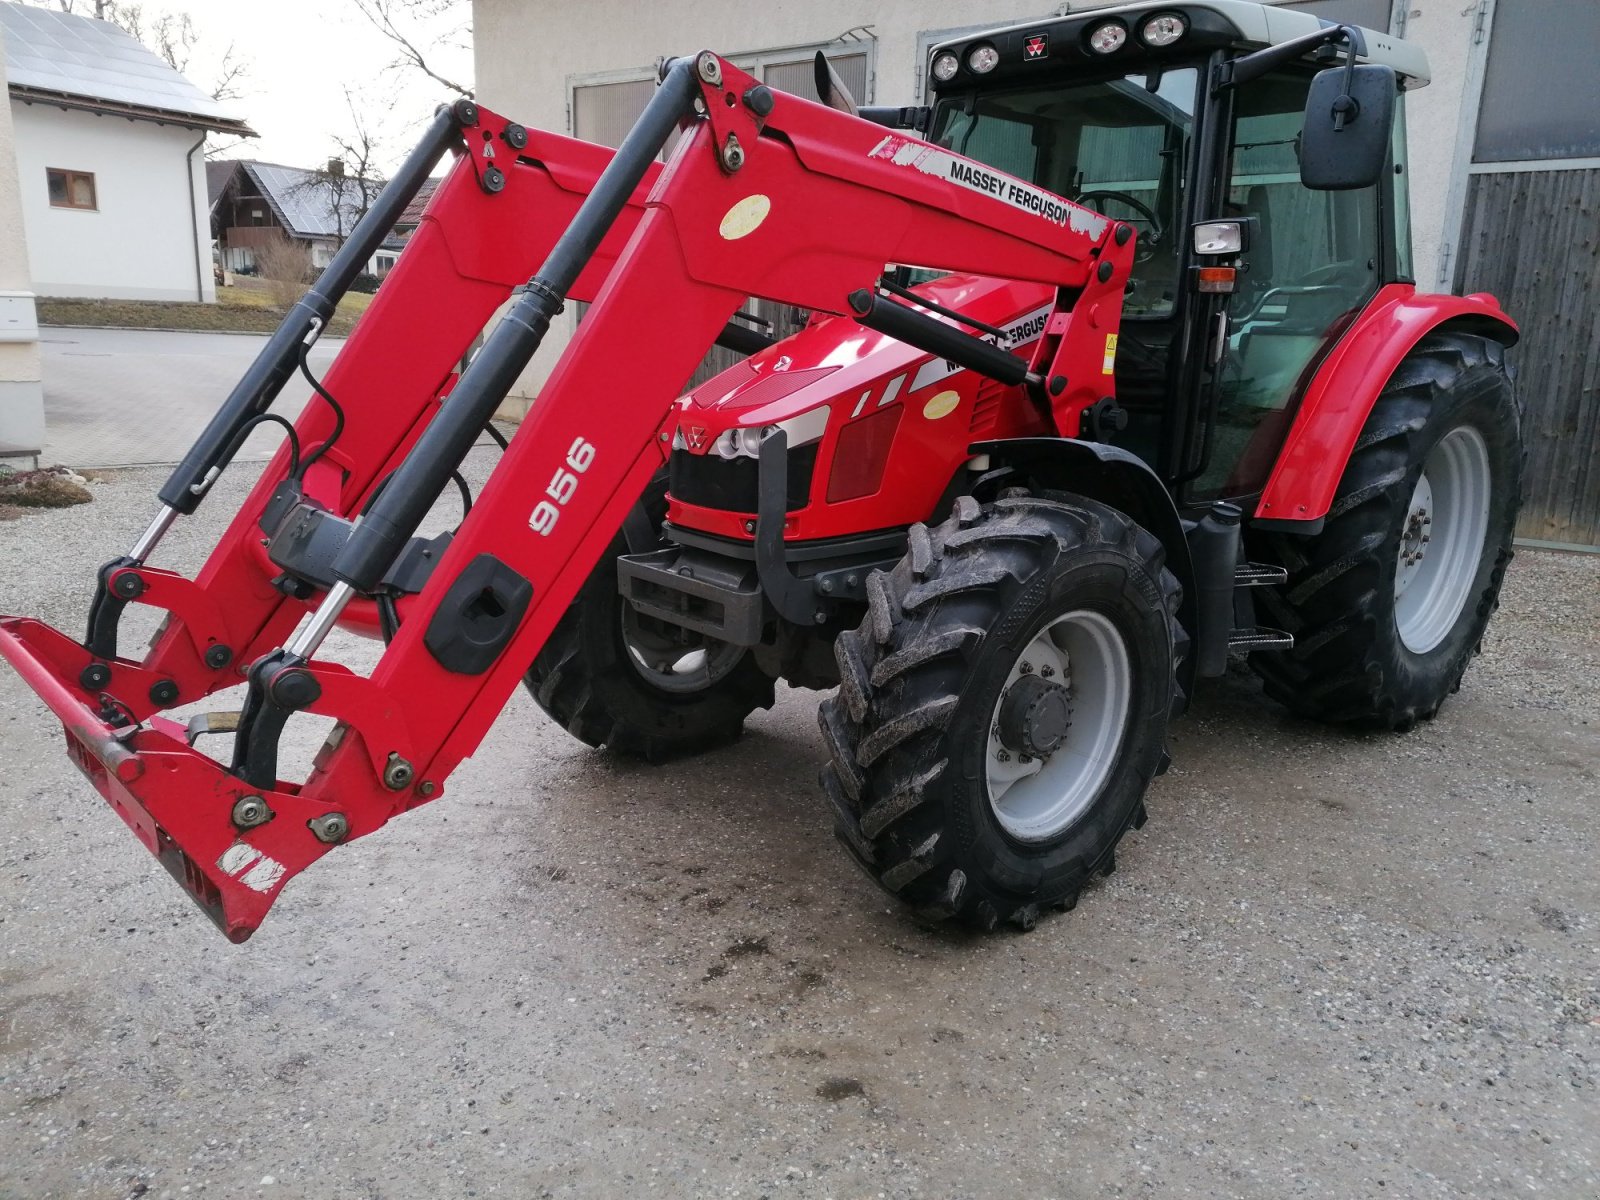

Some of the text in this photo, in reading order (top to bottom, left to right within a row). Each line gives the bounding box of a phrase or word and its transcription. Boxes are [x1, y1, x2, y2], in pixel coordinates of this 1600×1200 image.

[950, 161, 1071, 223] MASSEY FERGUSON
[1006, 313, 1049, 344] ERGUS
[528, 436, 596, 537] 956
